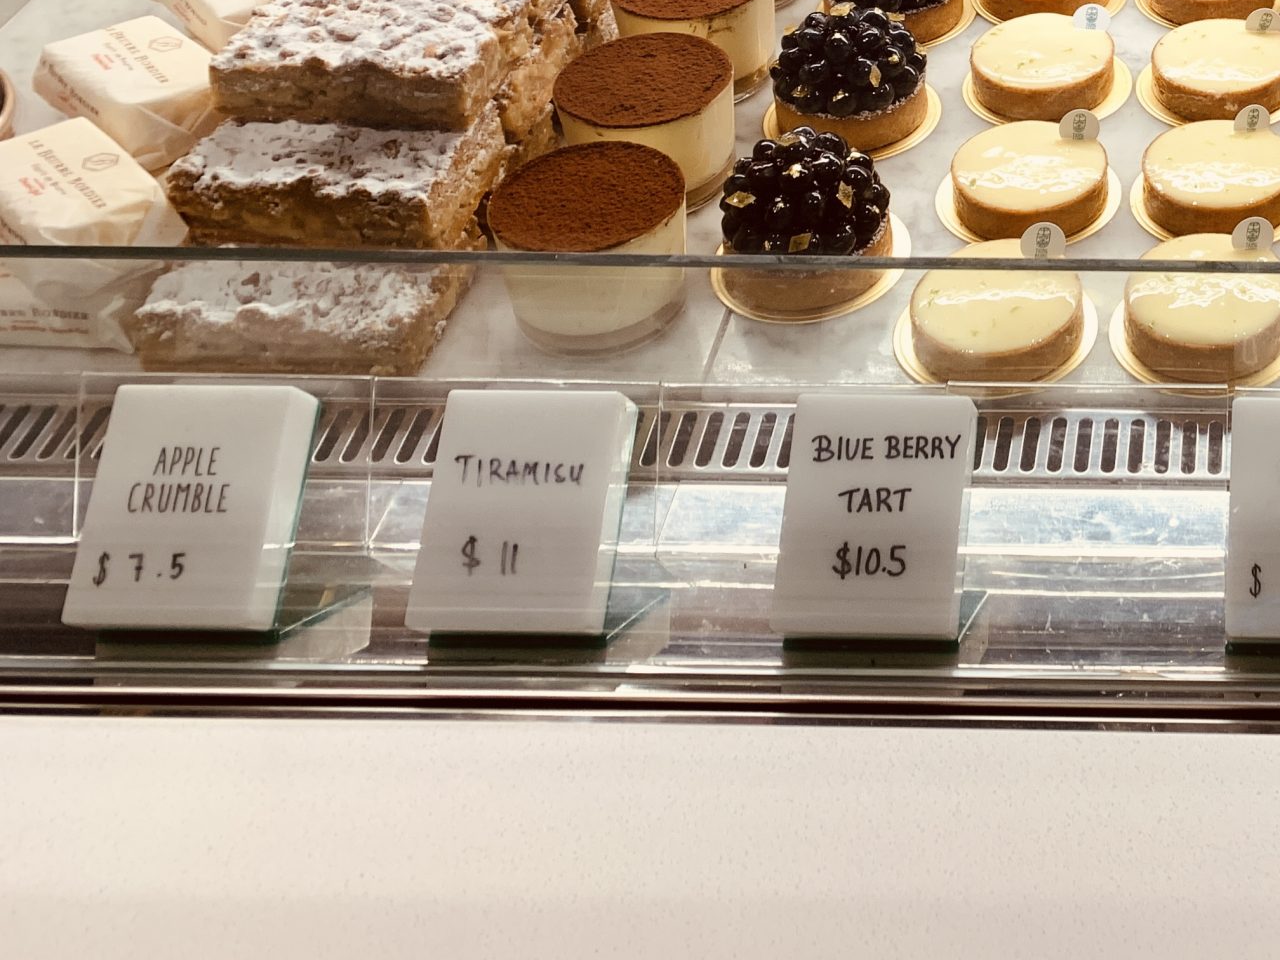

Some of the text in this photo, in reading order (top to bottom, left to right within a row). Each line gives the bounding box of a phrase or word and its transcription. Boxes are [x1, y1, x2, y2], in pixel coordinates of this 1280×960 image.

[153, 446, 221, 476] APPLE
[884, 434, 962, 459] BERRY
[454, 454, 584, 487] TIRAMISU
[127, 482, 230, 513] CRUMBLE
[838, 487, 912, 513] TART
[832, 542, 907, 580] $10.5
